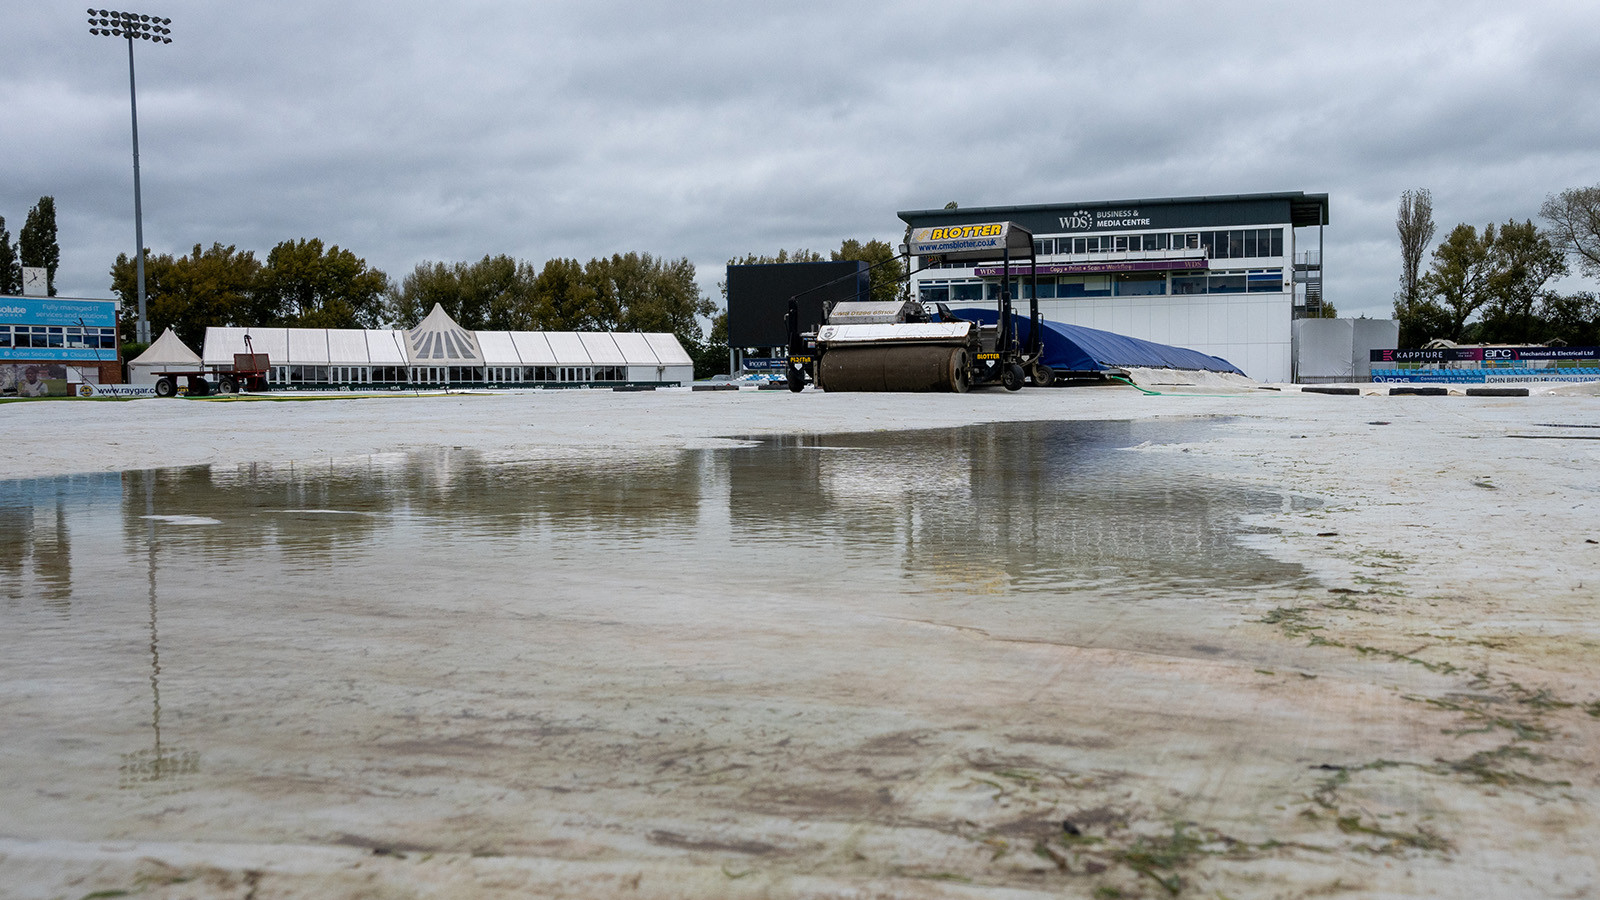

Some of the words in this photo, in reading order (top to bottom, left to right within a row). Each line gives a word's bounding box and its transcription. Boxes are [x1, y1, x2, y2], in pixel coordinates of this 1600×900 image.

[1096, 210, 1132, 218] BUSINESS
[1059, 216, 1088, 228] WDS
[1122, 218, 1150, 226] CENTRE
[930, 224, 1002, 240] BLOTTER
[918, 238, 997, 251] www.cmsblotter.co.uk
[1485, 349, 1511, 357] arc
[98, 387, 156, 395] www.raygar.c
